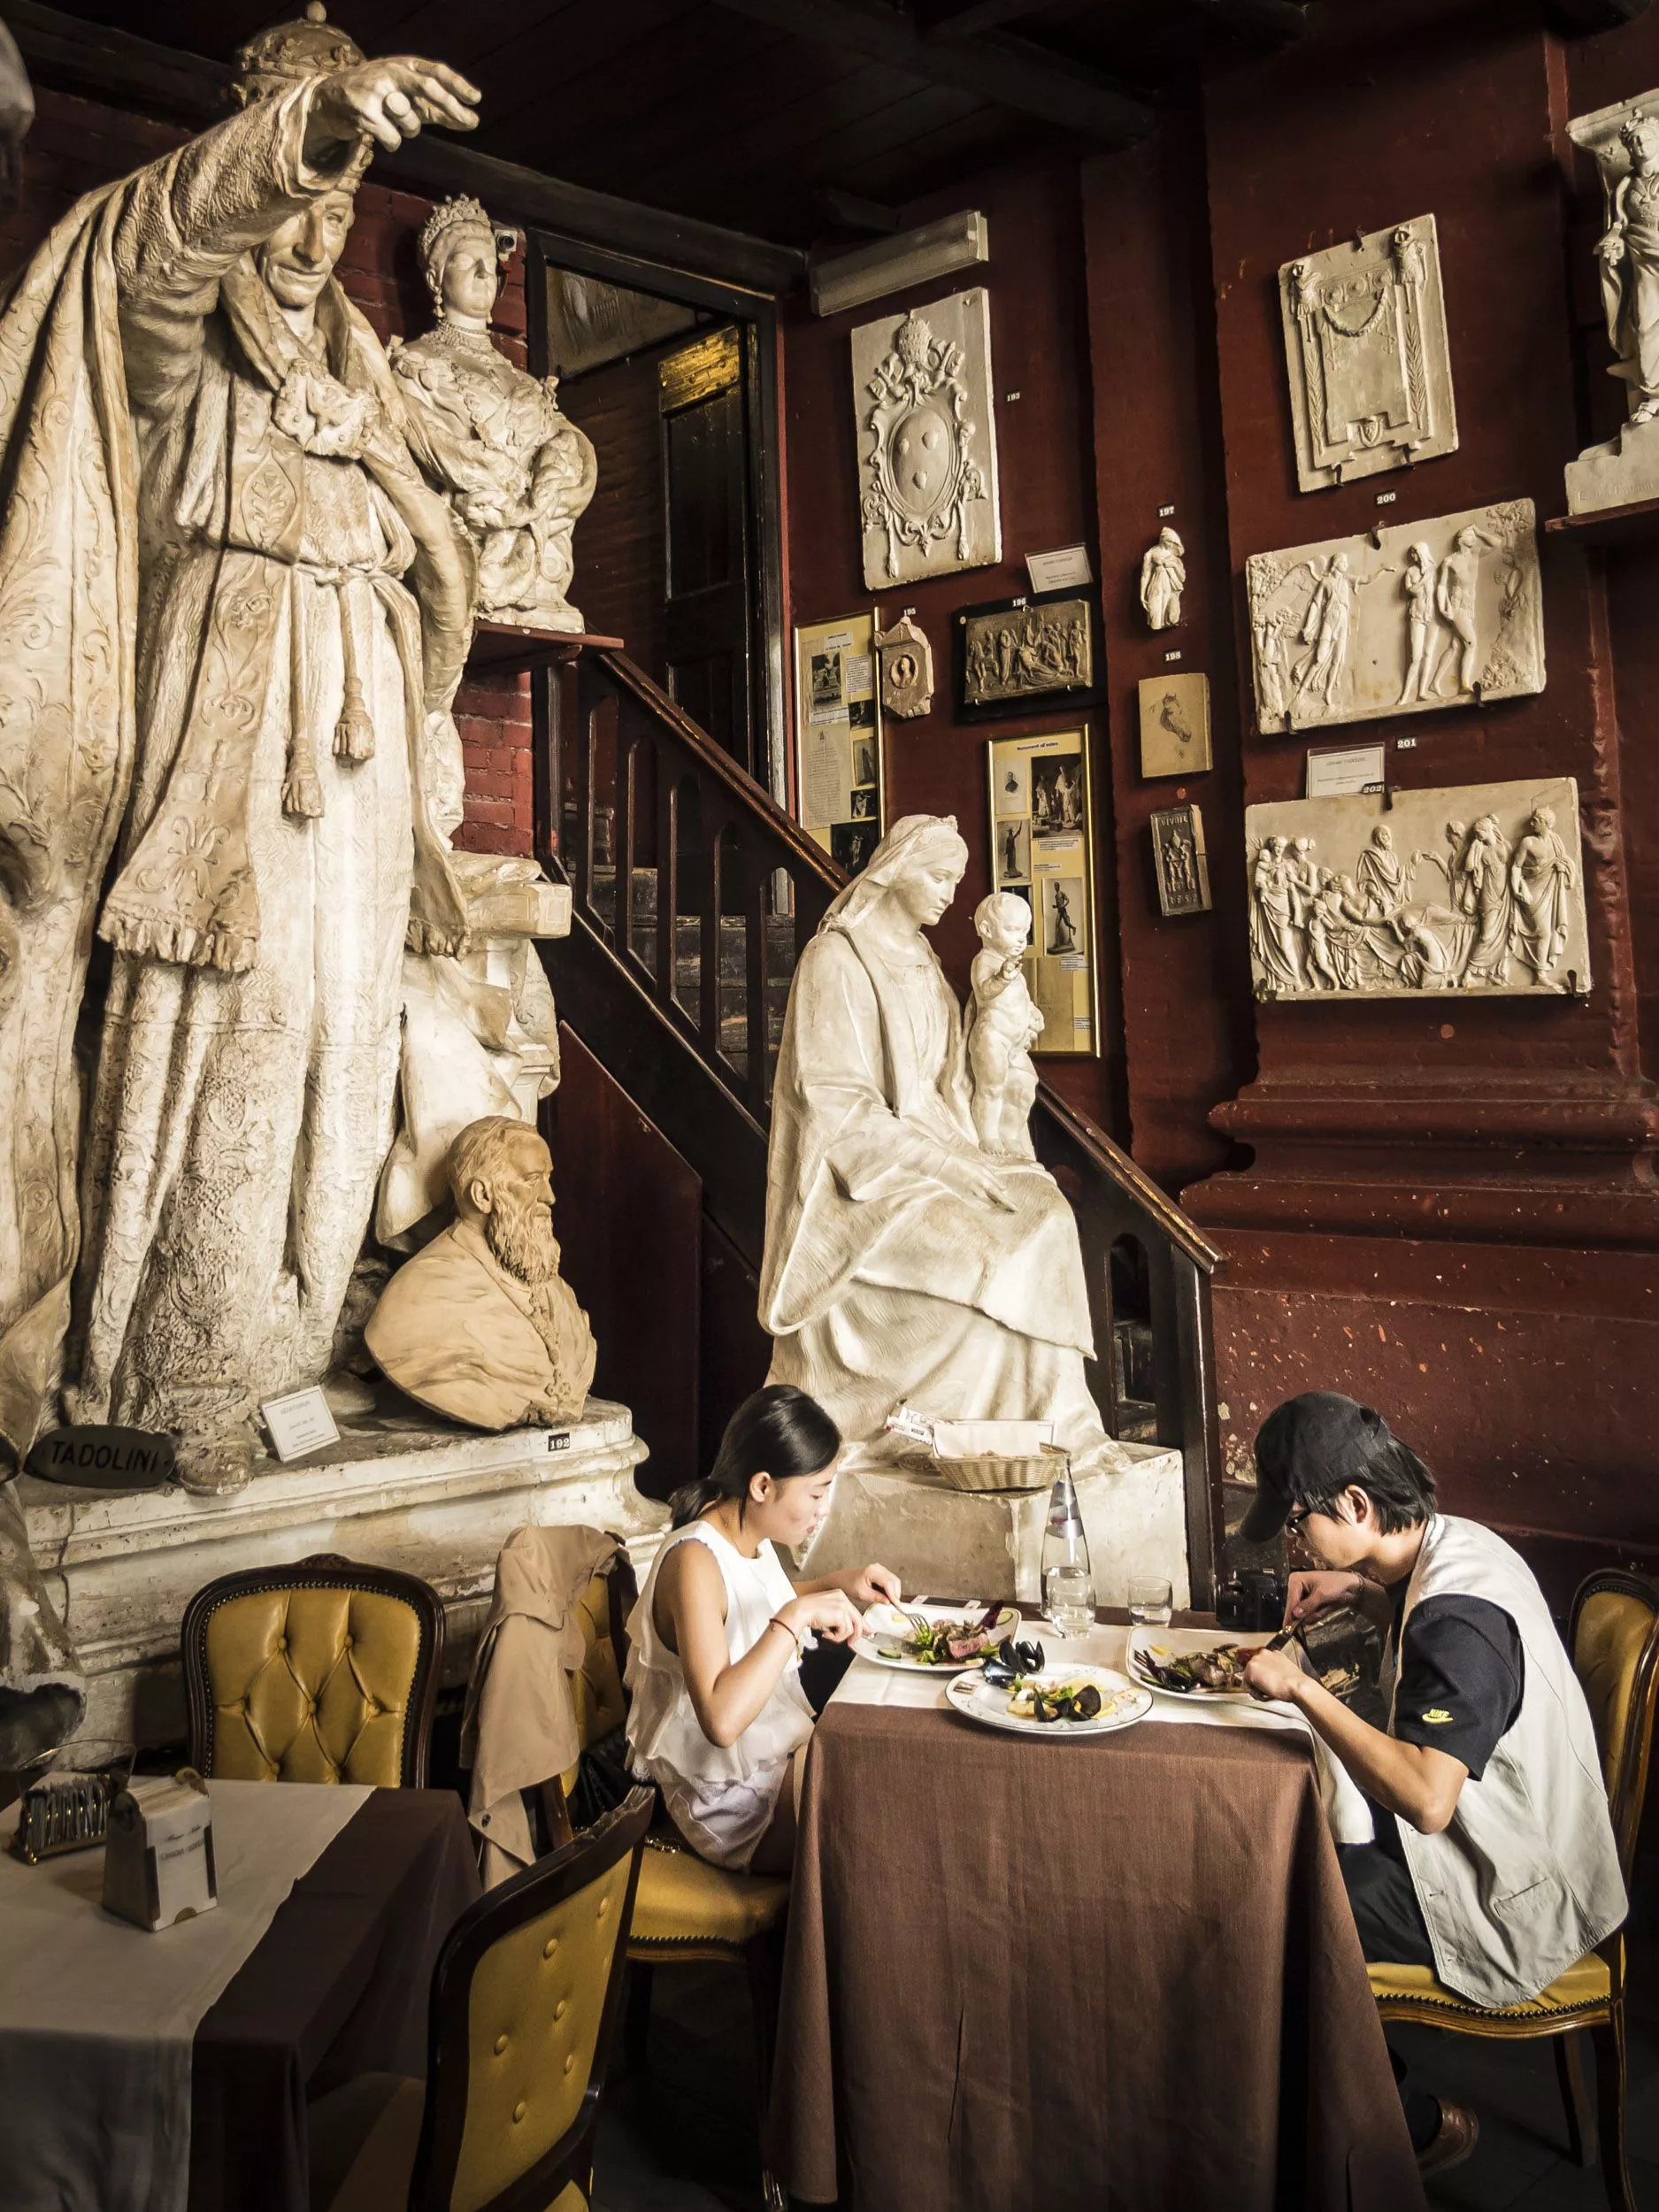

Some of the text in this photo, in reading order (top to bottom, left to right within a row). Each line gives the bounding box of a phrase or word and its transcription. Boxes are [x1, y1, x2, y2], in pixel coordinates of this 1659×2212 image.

[1377, 492, 1396, 504] 200
[1159, 505, 1174, 518] 197
[1012, 597, 1026, 607] 196
[1397, 738, 1417, 749] 201
[1363, 784, 1383, 794] 202
[52, 1440, 159, 1473] TADOLINI
